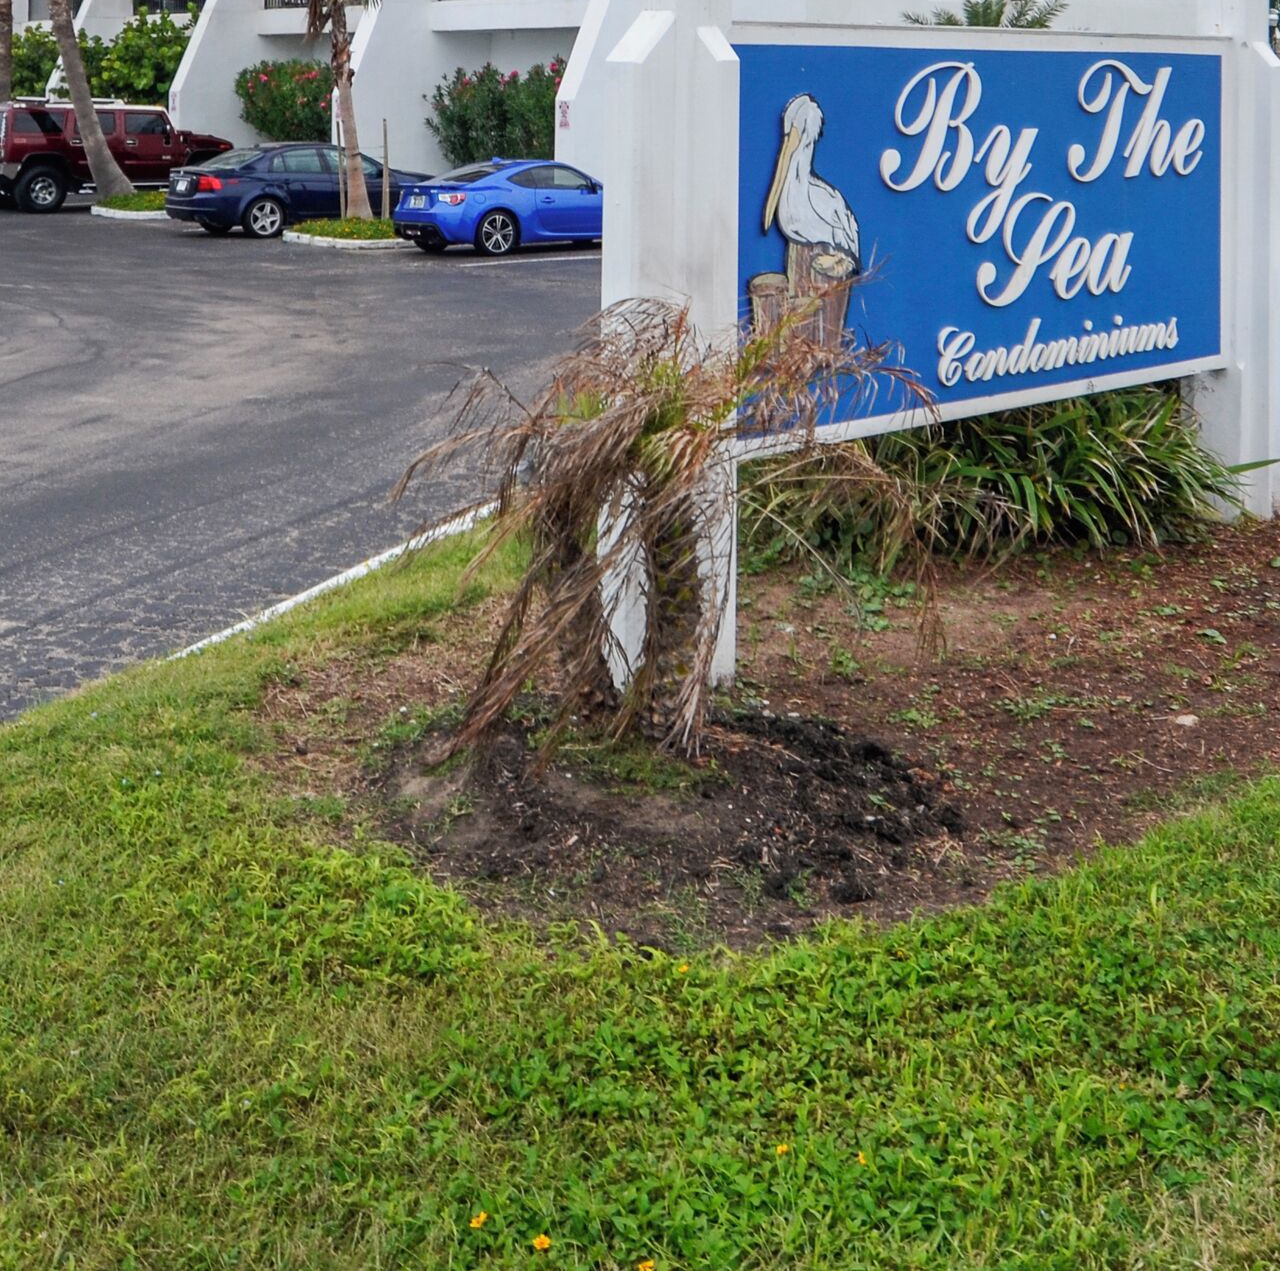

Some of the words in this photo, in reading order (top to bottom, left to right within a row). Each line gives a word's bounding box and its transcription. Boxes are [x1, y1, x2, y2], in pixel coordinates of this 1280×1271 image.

[879, 60, 1039, 245] By
[1066, 58, 1206, 183] The
[975, 191, 1136, 308] Sea
[936, 314, 1180, 388] Condominiums
